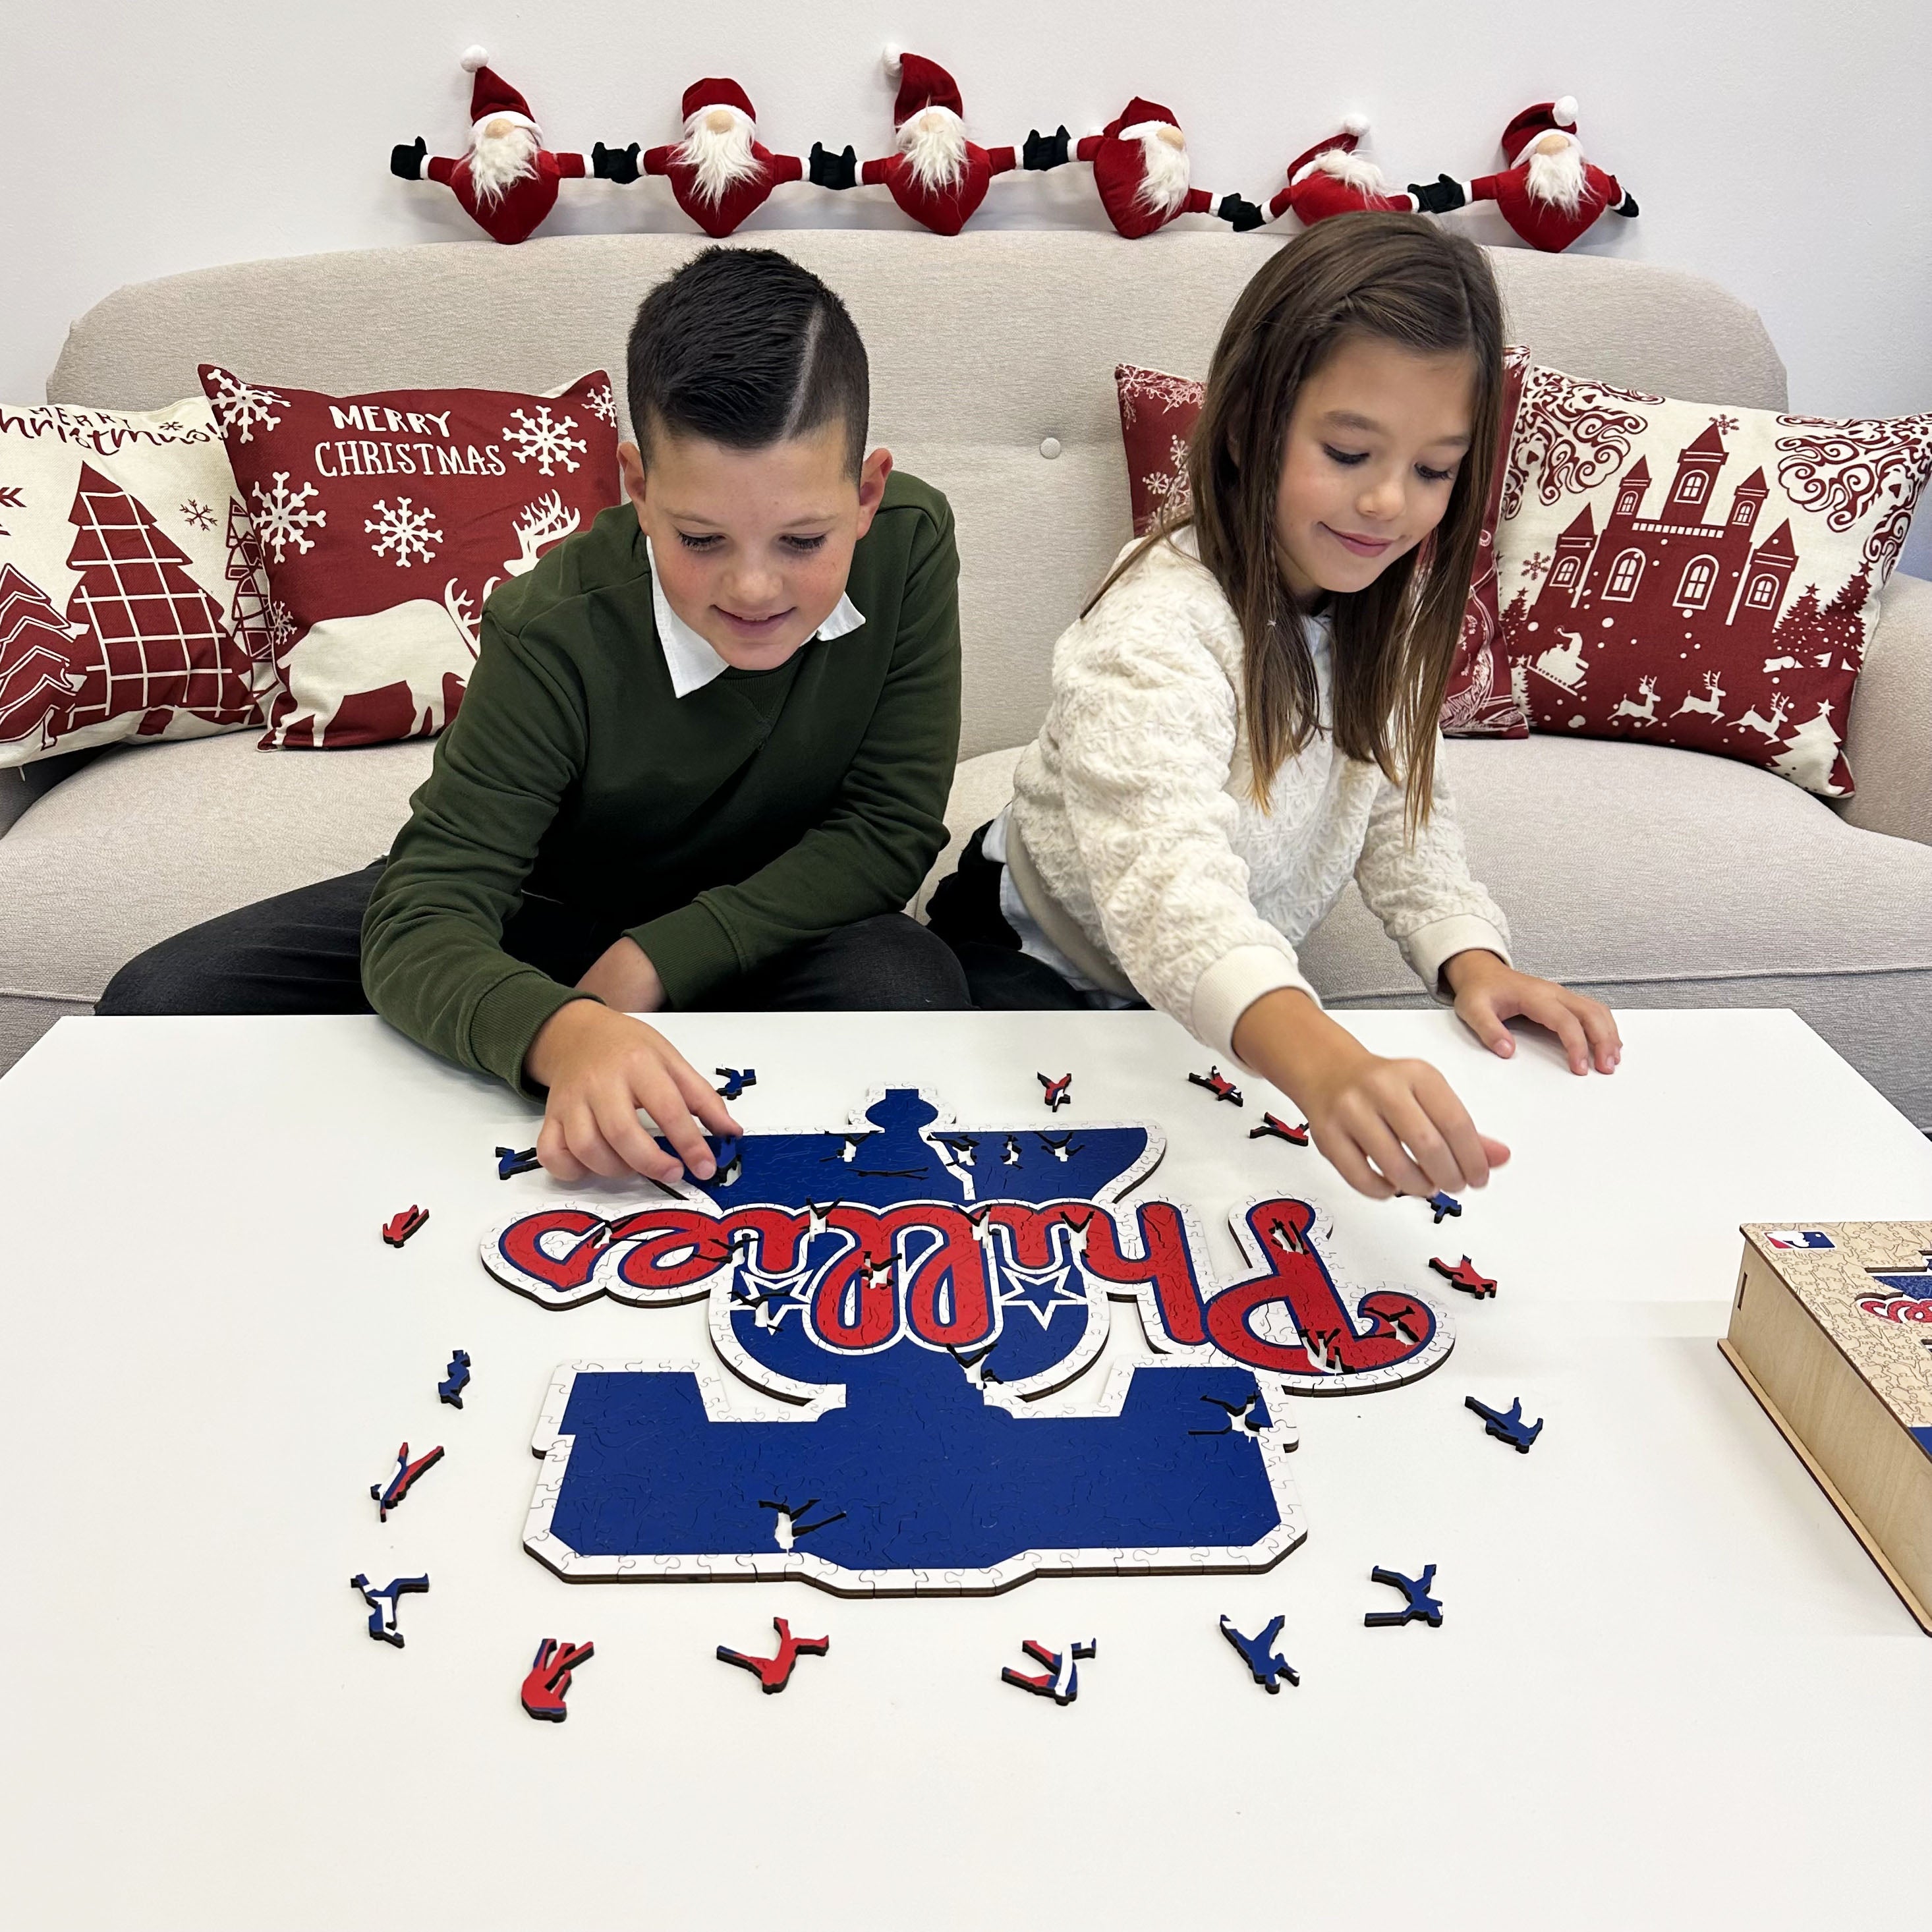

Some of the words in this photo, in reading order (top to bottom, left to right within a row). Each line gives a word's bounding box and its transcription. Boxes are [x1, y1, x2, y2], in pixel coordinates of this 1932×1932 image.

[0, 408, 224, 456] hristmas!
[328, 405, 451, 438] MERRY
[314, 440, 506, 477] CHRISTMAS
[499, 1198, 1436, 1375] Phillies
